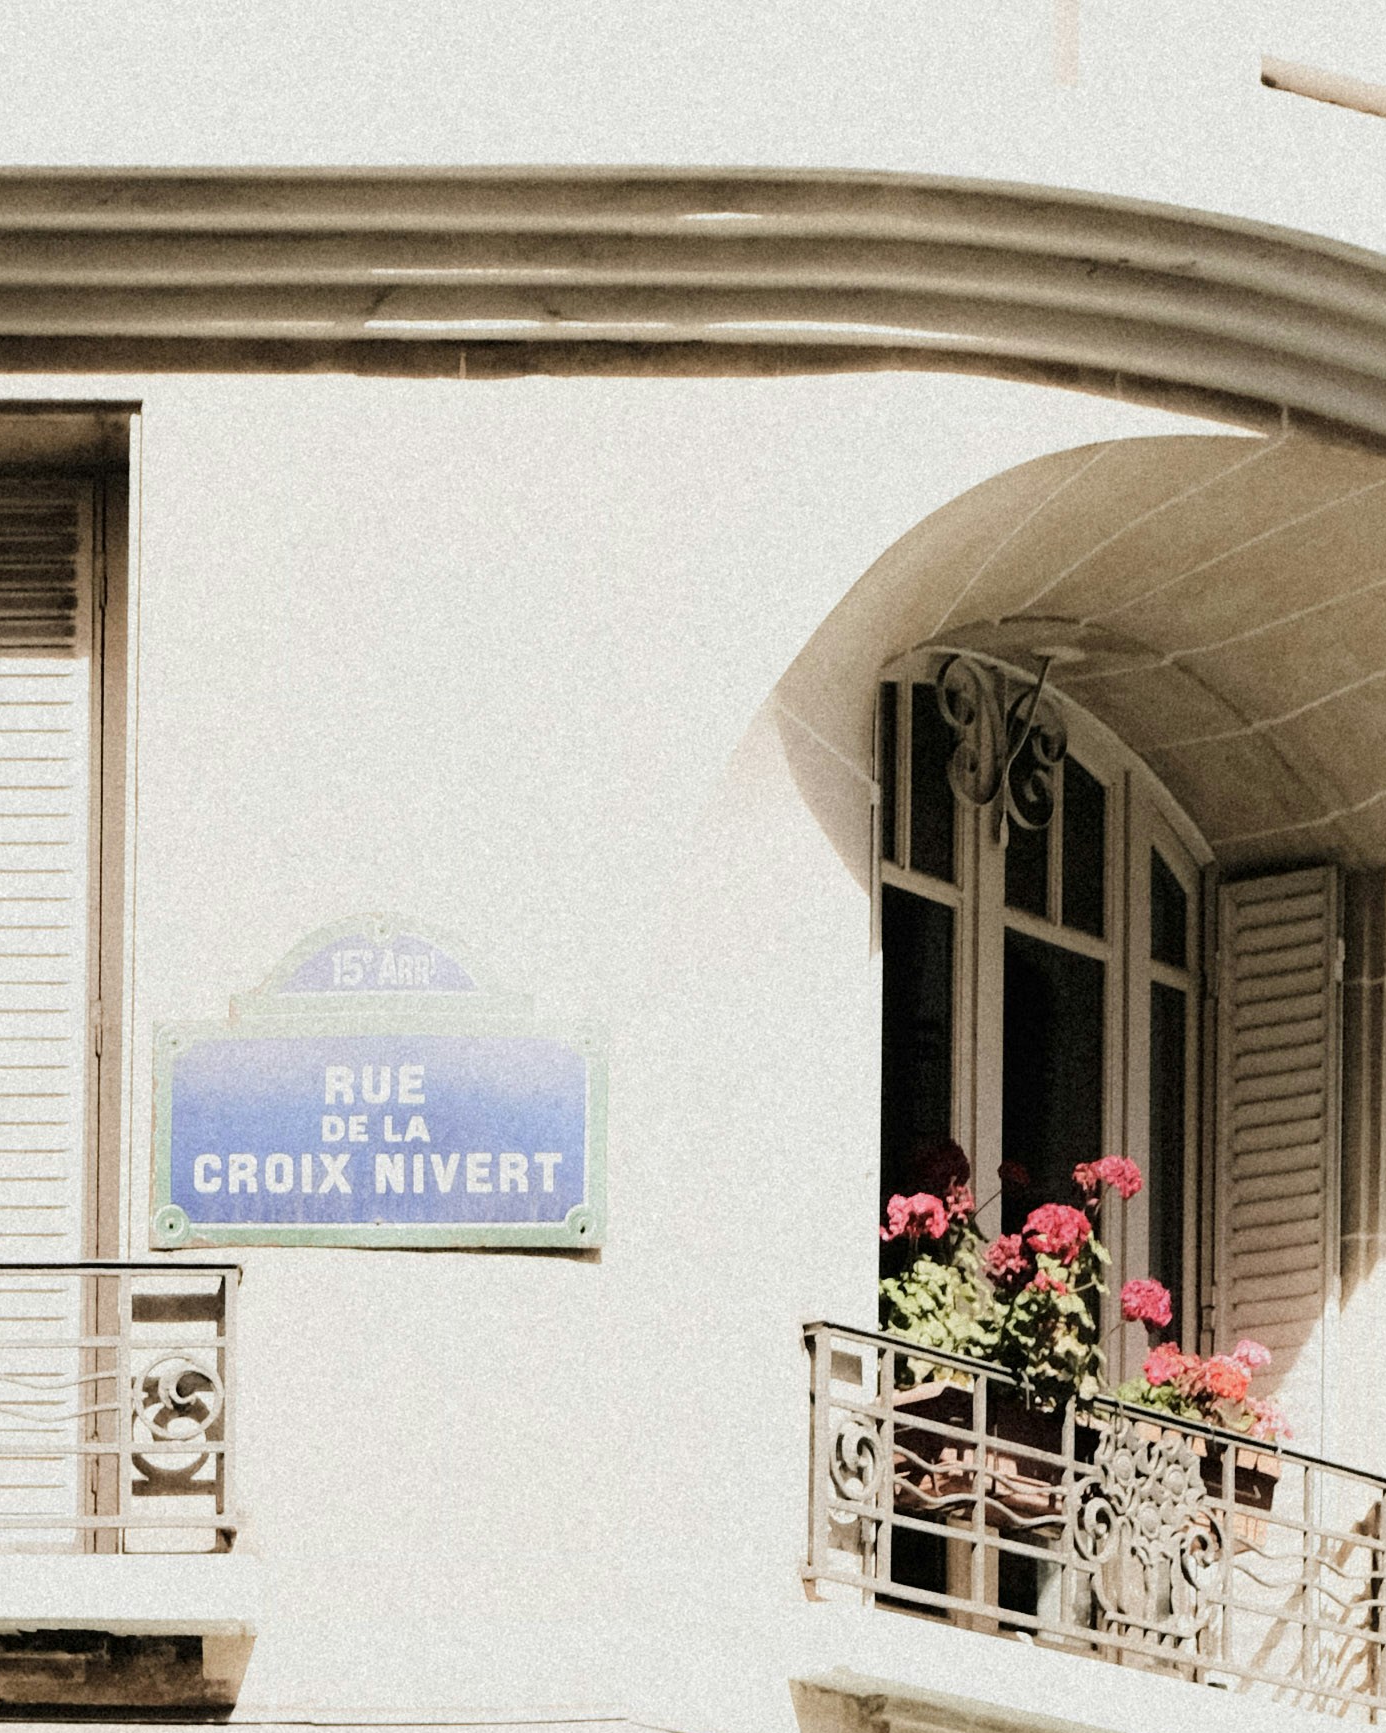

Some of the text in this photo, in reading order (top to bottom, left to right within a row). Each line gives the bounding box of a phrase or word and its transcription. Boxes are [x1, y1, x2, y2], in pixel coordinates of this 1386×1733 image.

[324, 1064, 426, 1105] RUE
[321, 1114, 431, 1143] DE LA
[192, 1152, 564, 1194] CROIX NIVERT
